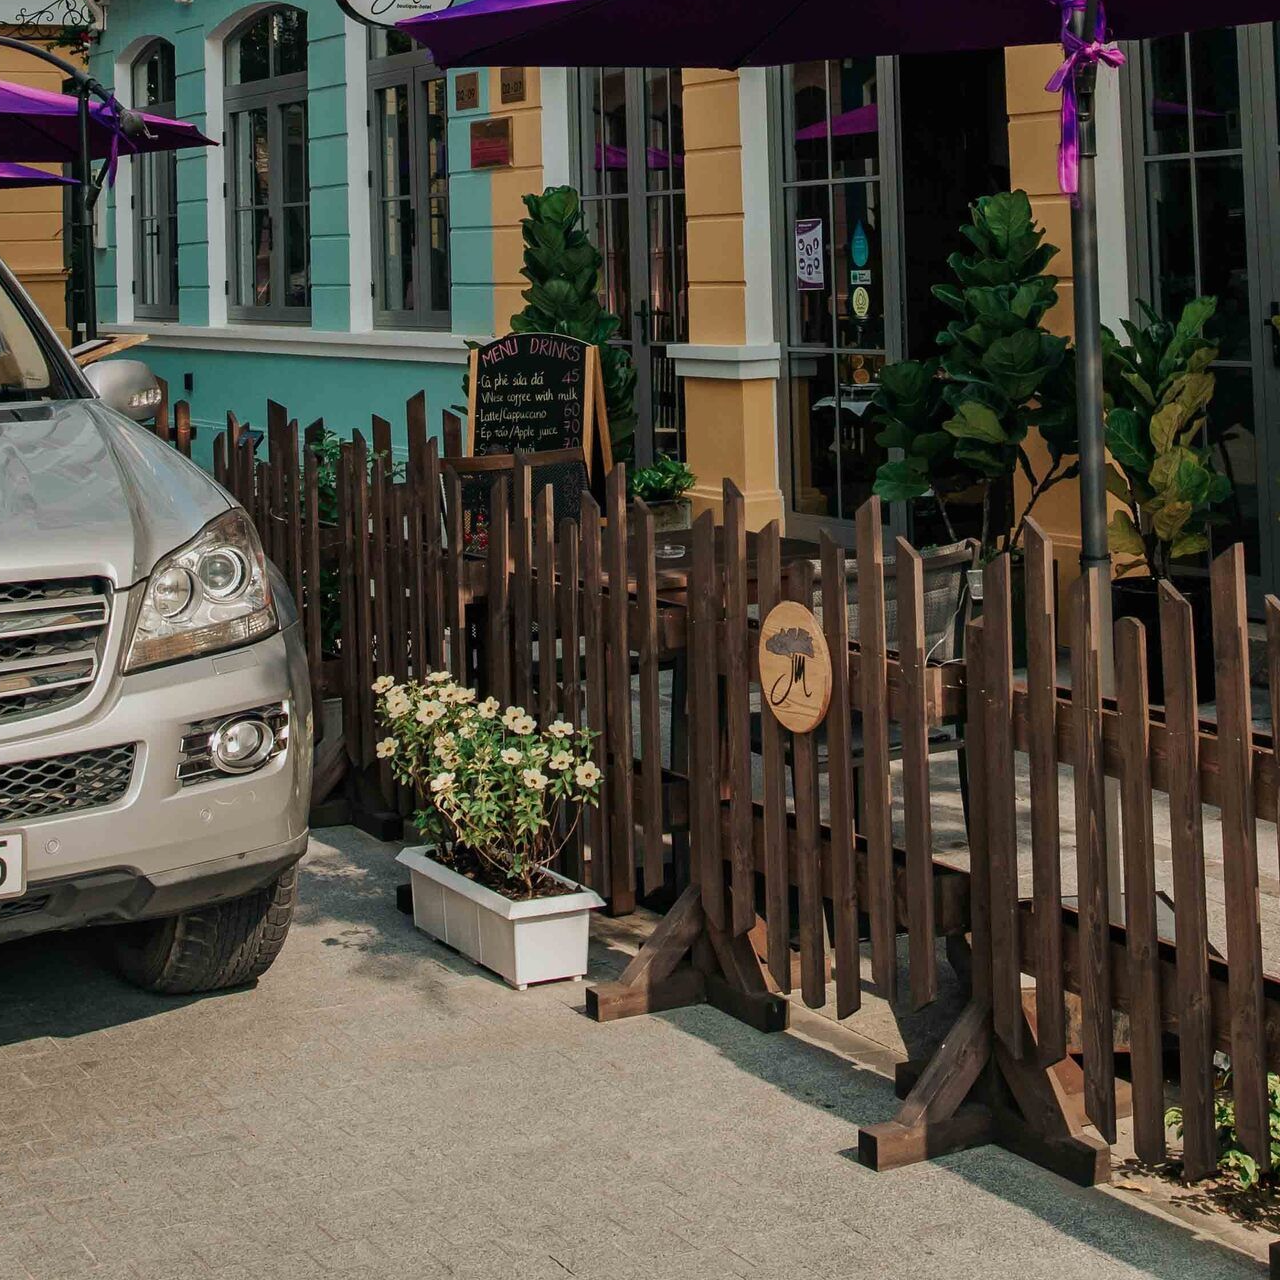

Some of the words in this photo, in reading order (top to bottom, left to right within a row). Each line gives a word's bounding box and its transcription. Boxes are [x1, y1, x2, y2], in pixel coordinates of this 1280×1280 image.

[482, 337, 519, 368] MENU
[562, 368, 580, 384] 45
[506, 393, 531, 407] coffee
[535, 388, 554, 401] with
[558, 386, 578, 401] milk
[563, 402, 580, 417] 60
[537, 426, 559, 440] juice
[563, 419, 580, 434] 70
